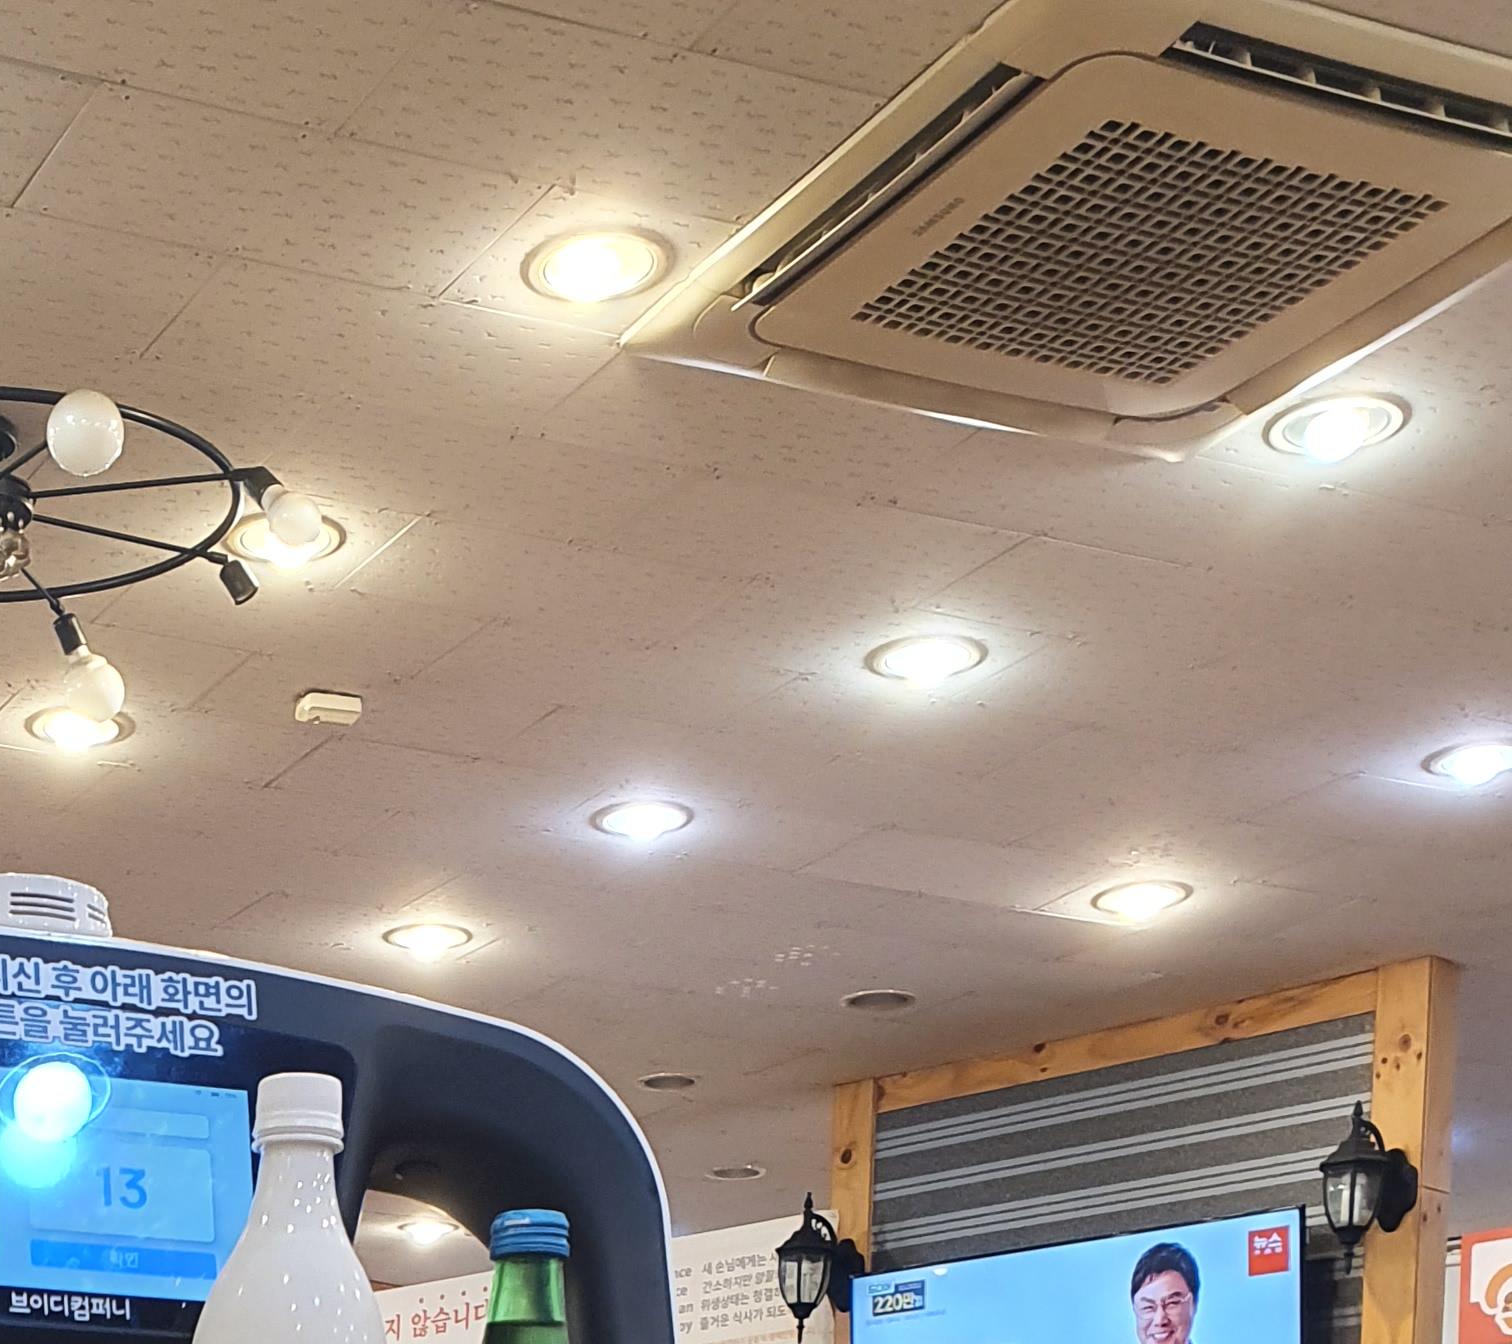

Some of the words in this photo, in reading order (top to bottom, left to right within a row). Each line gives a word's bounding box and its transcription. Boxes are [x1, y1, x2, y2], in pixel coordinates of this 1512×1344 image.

[51, 963, 82, 999] 후
[90, 968, 152, 1008] 아래
[160, 976, 255, 1018] 화면의
[59, 1010, 221, 1055] 눌러주세요
[96, 1166, 148, 1210] 13
[9, 1291, 131, 1321] 브이디컴퍼니
